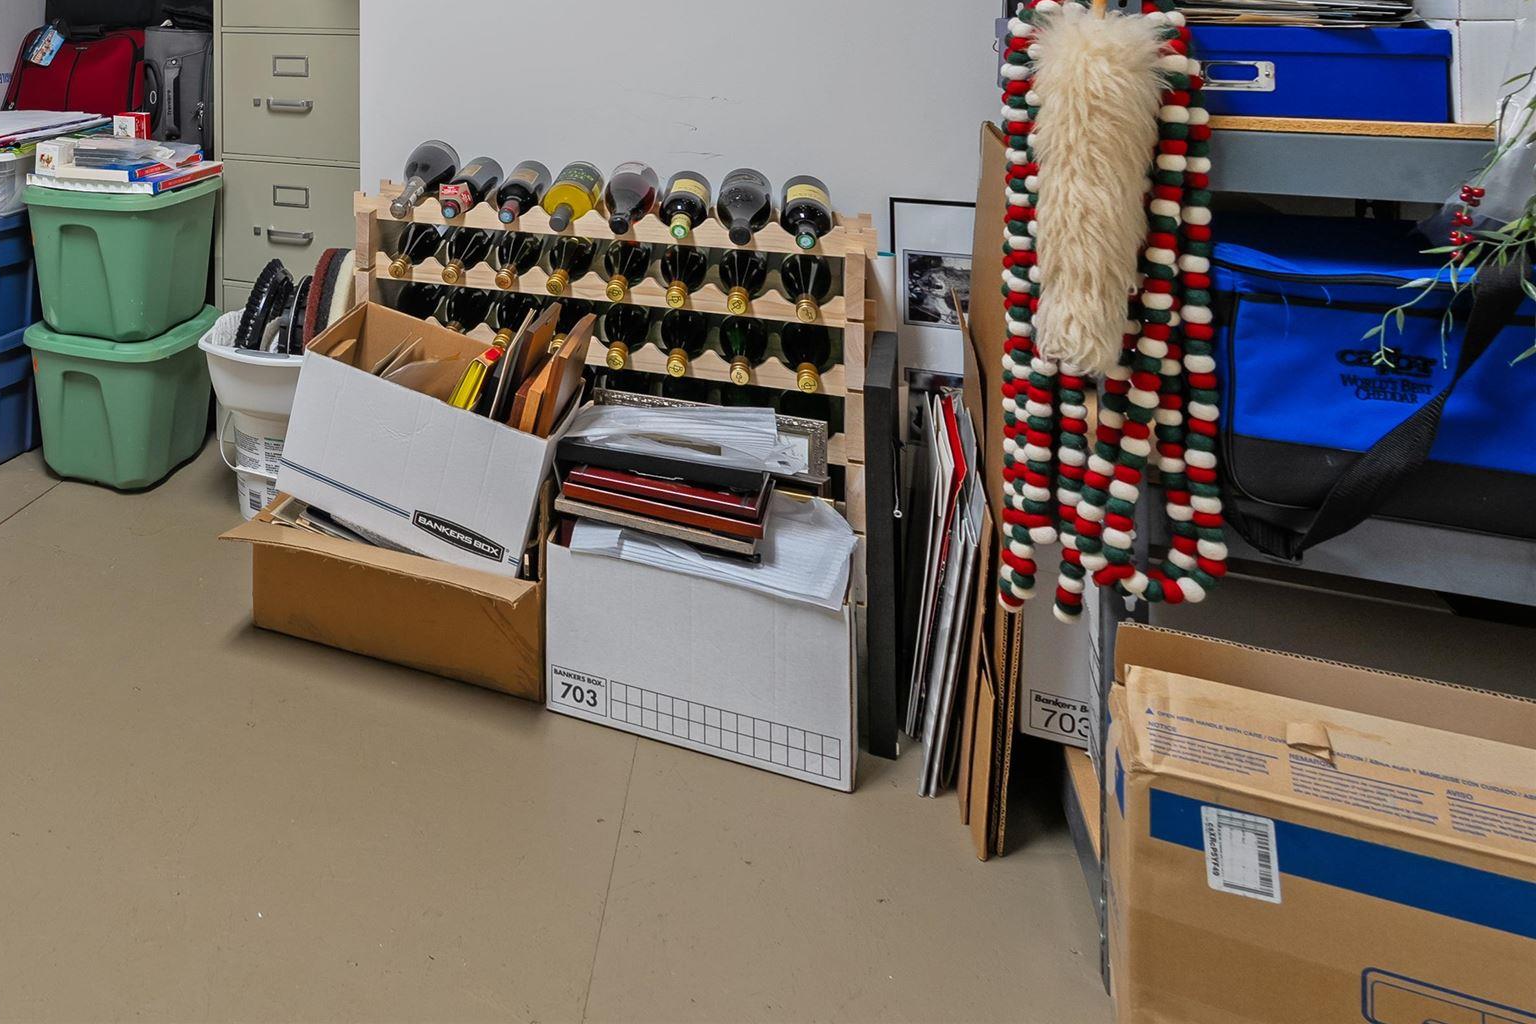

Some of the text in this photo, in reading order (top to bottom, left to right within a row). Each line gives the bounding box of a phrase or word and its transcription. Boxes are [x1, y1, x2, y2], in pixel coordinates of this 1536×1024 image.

[418, 516, 500, 556] BANKERS BOX
[554, 668, 585, 682] BANKERS
[561, 681, 598, 707] 703
[1034, 694, 1077, 711] Bankers
[1041, 707, 1089, 738] 703
[1148, 721, 1177, 733] NOTICE
